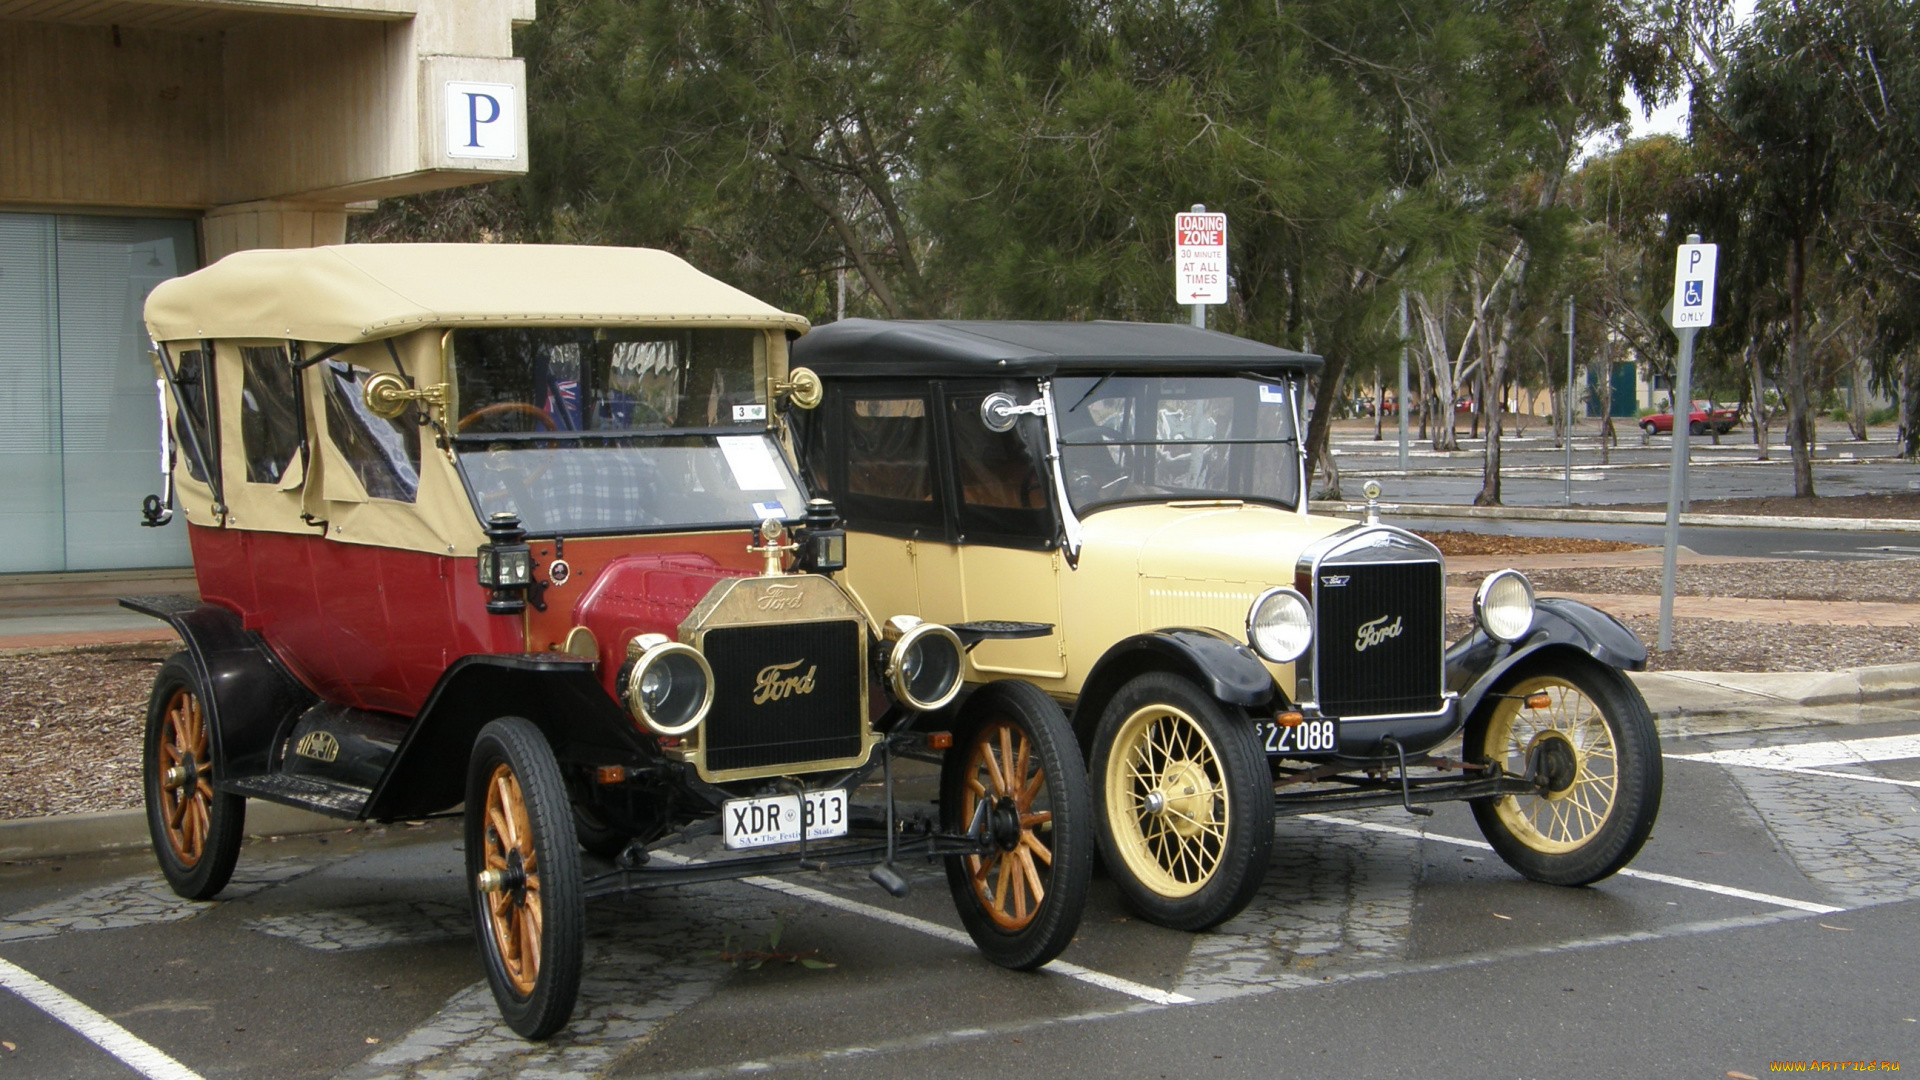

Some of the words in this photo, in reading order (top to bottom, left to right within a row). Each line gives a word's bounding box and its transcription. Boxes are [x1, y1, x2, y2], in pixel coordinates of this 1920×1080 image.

[461, 92, 500, 148] P
[1179, 216, 1223, 231] LOADING
[1183, 231, 1219, 245] ZONE
[1180, 249, 1192, 259] 30
[1194, 251, 1222, 259] MINUTE
[1689, 249, 1702, 274] P
[1183, 262, 1195, 272] AT
[1200, 262, 1220, 272] ALL
[1185, 274, 1218, 284] TIMES
[1680, 312, 1705, 322] ONLY
[738, 406, 745, 417] 3
[757, 584, 804, 611] Ford
[1355, 615, 1403, 652] Ford
[753, 658, 817, 705] Ford
[733, 804, 781, 836] XDR
[739, 836, 752, 845] SA
[814, 828, 834, 836] State
